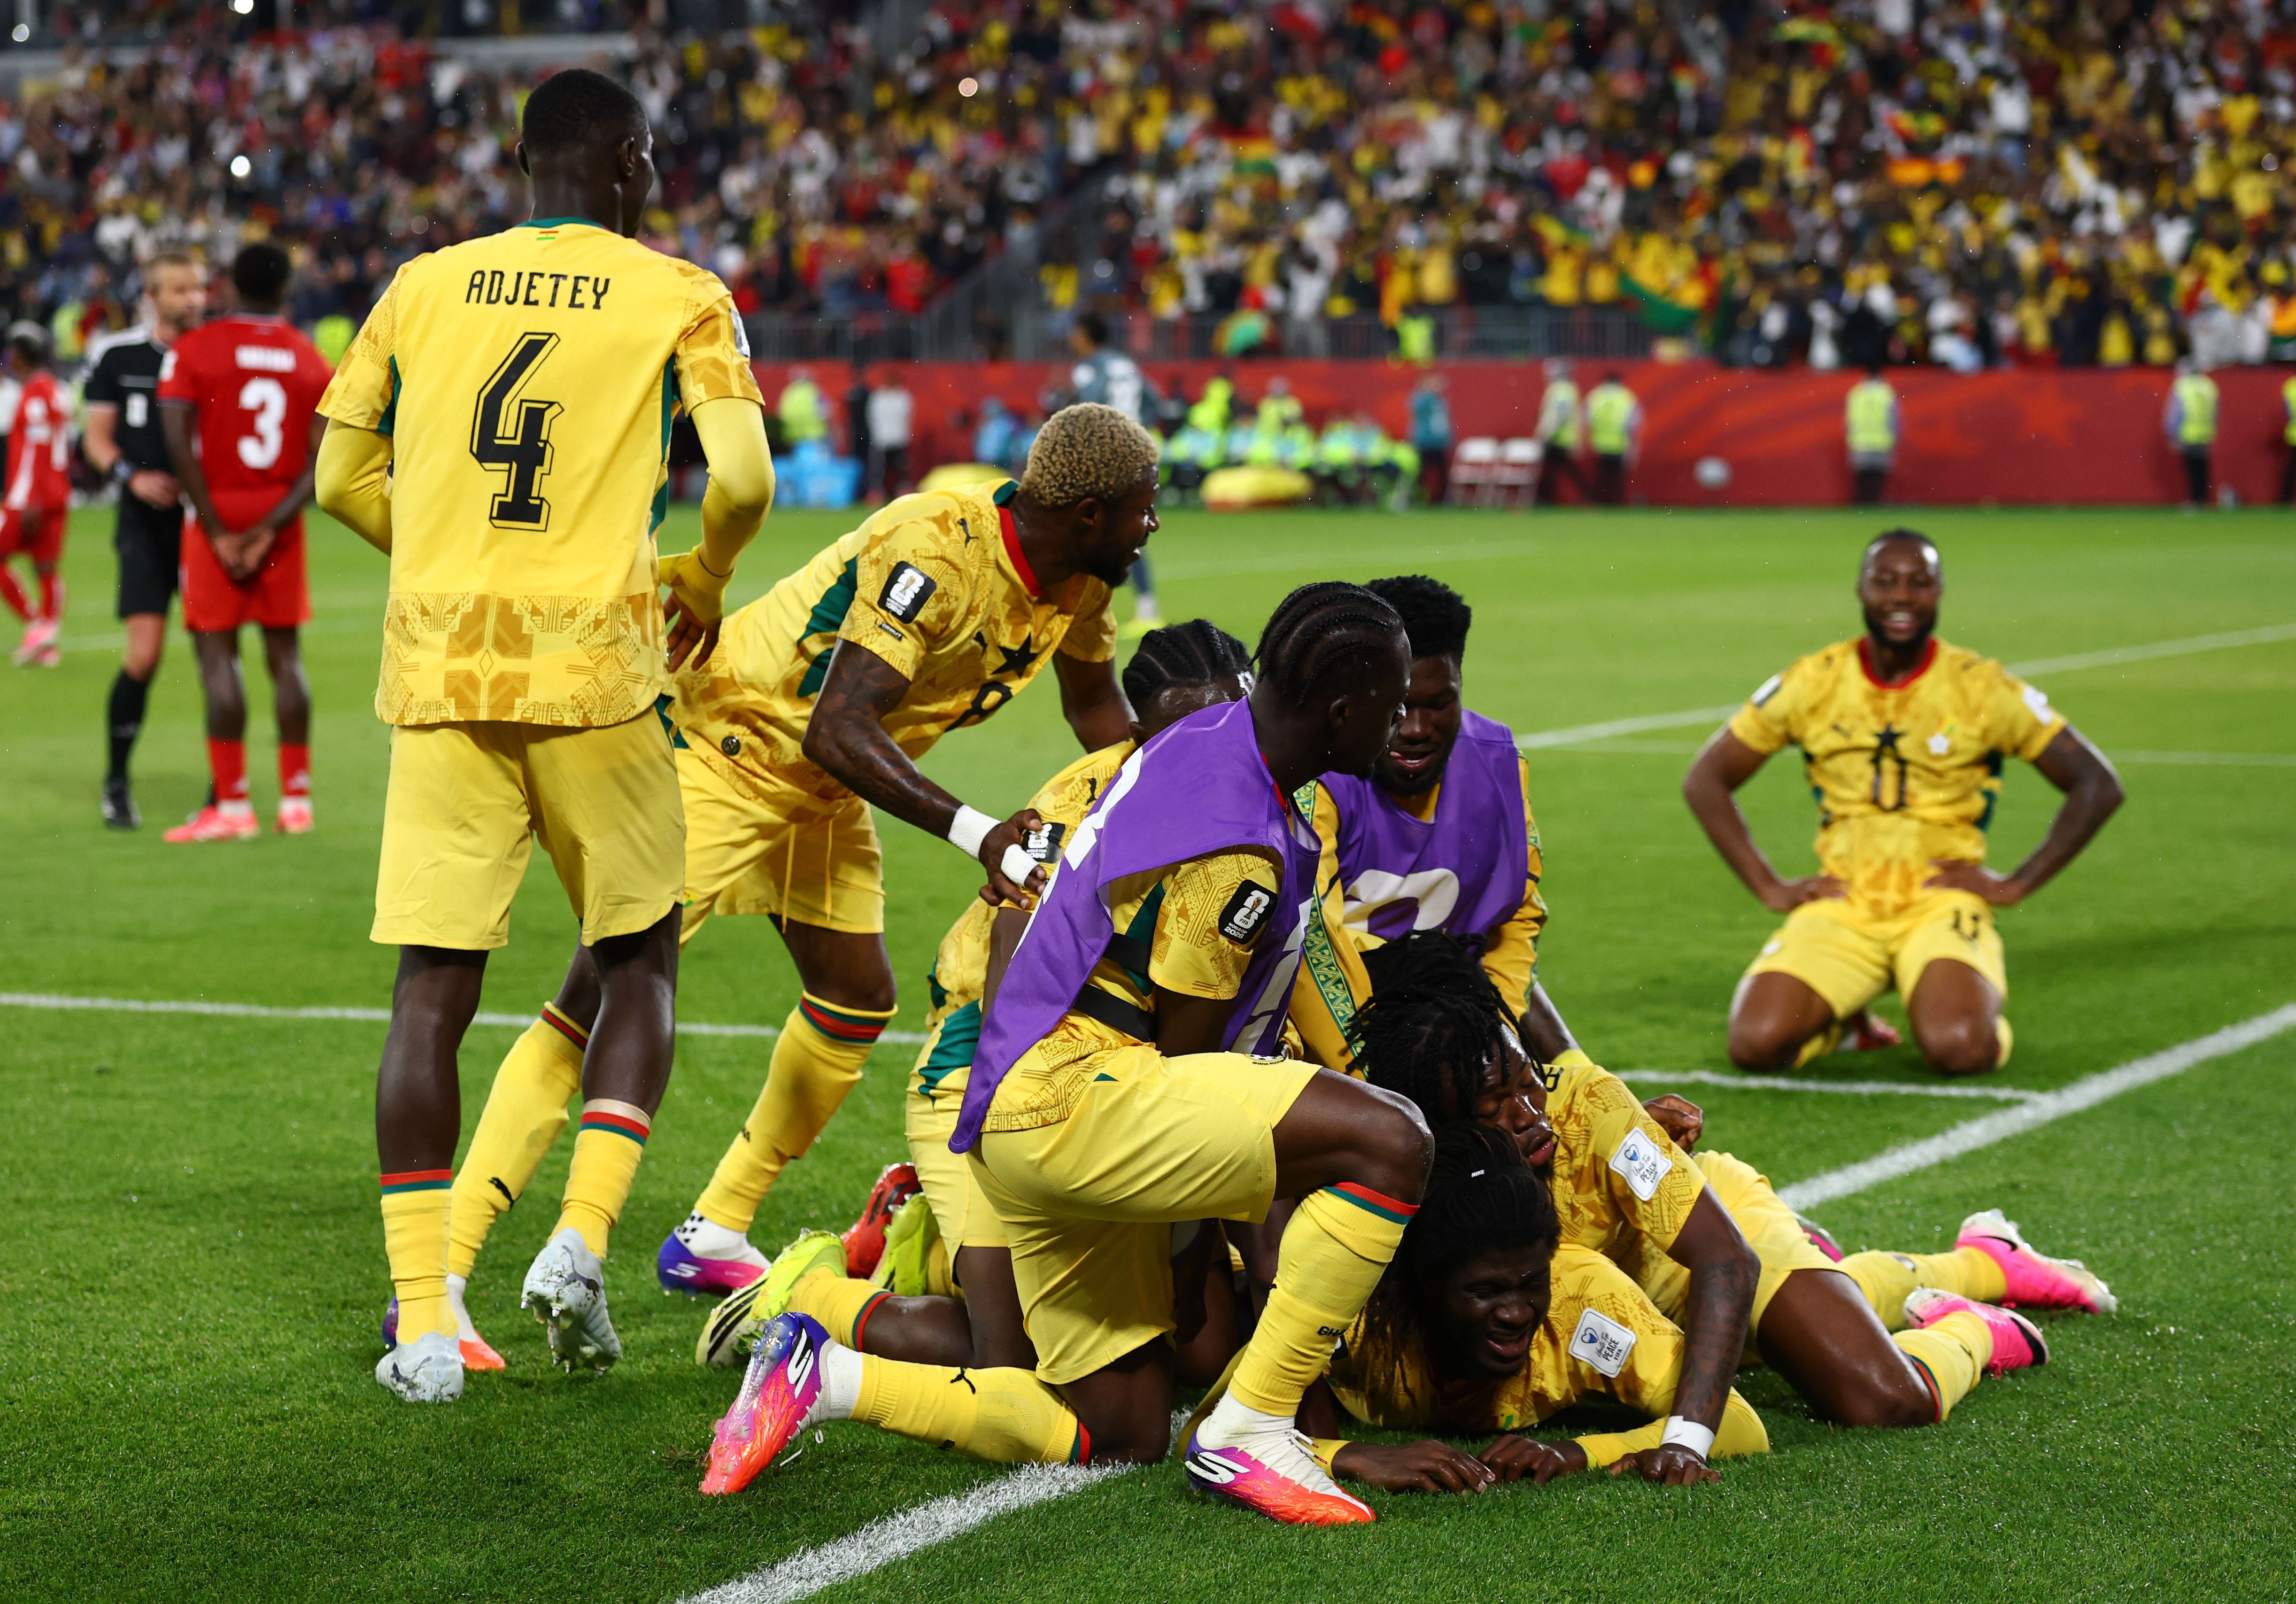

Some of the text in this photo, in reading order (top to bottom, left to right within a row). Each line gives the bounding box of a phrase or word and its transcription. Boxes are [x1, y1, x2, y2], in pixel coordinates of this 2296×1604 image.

[465, 269, 611, 310] ADJETEY
[237, 378, 287, 470] 3
[470, 332, 565, 532] 4
[1224, 926, 1245, 939] 2026
[1228, 922, 1241, 931] WORLD
[1471, 1169, 1485, 1178] NIKE
[1639, 1161, 1657, 1184] PEACE
[1602, 1338, 1620, 1362] PEACE
[1614, 1348, 1623, 1361] FIFA
